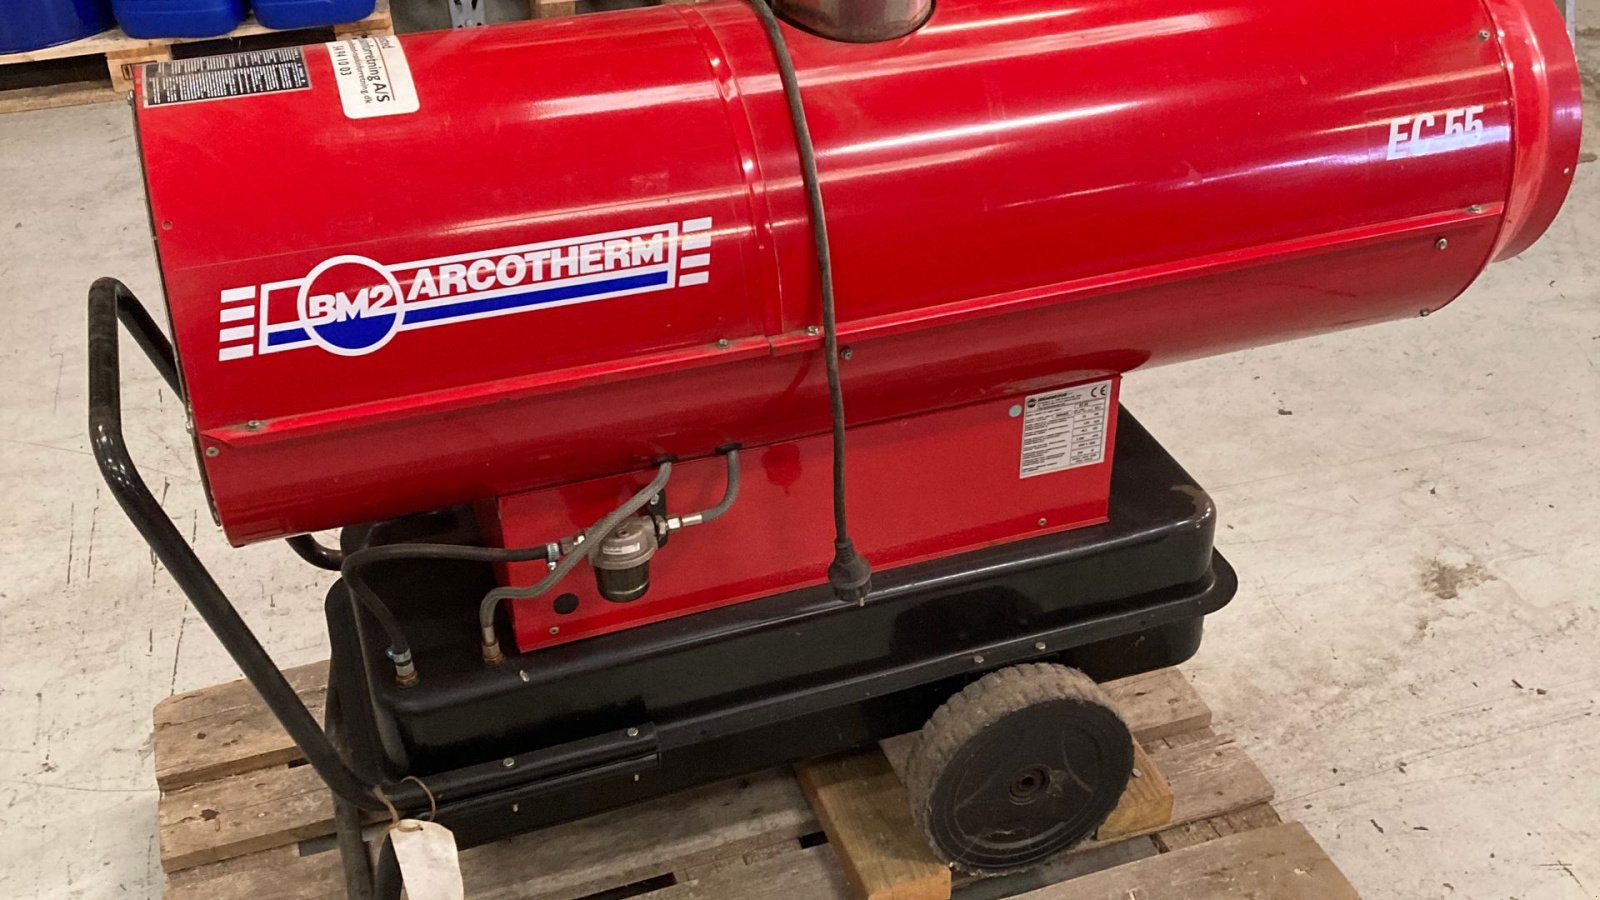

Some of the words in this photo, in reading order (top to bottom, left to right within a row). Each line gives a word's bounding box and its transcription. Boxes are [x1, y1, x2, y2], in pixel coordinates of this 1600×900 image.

[337, 58, 350, 66] 10
[339, 66, 353, 76] 03
[372, 83, 390, 102] A/S
[1386, 112, 1435, 161] EC
[1445, 105, 1484, 147] 55
[308, 283, 396, 322] BM2
[405, 233, 663, 302] ARCOTHERM
